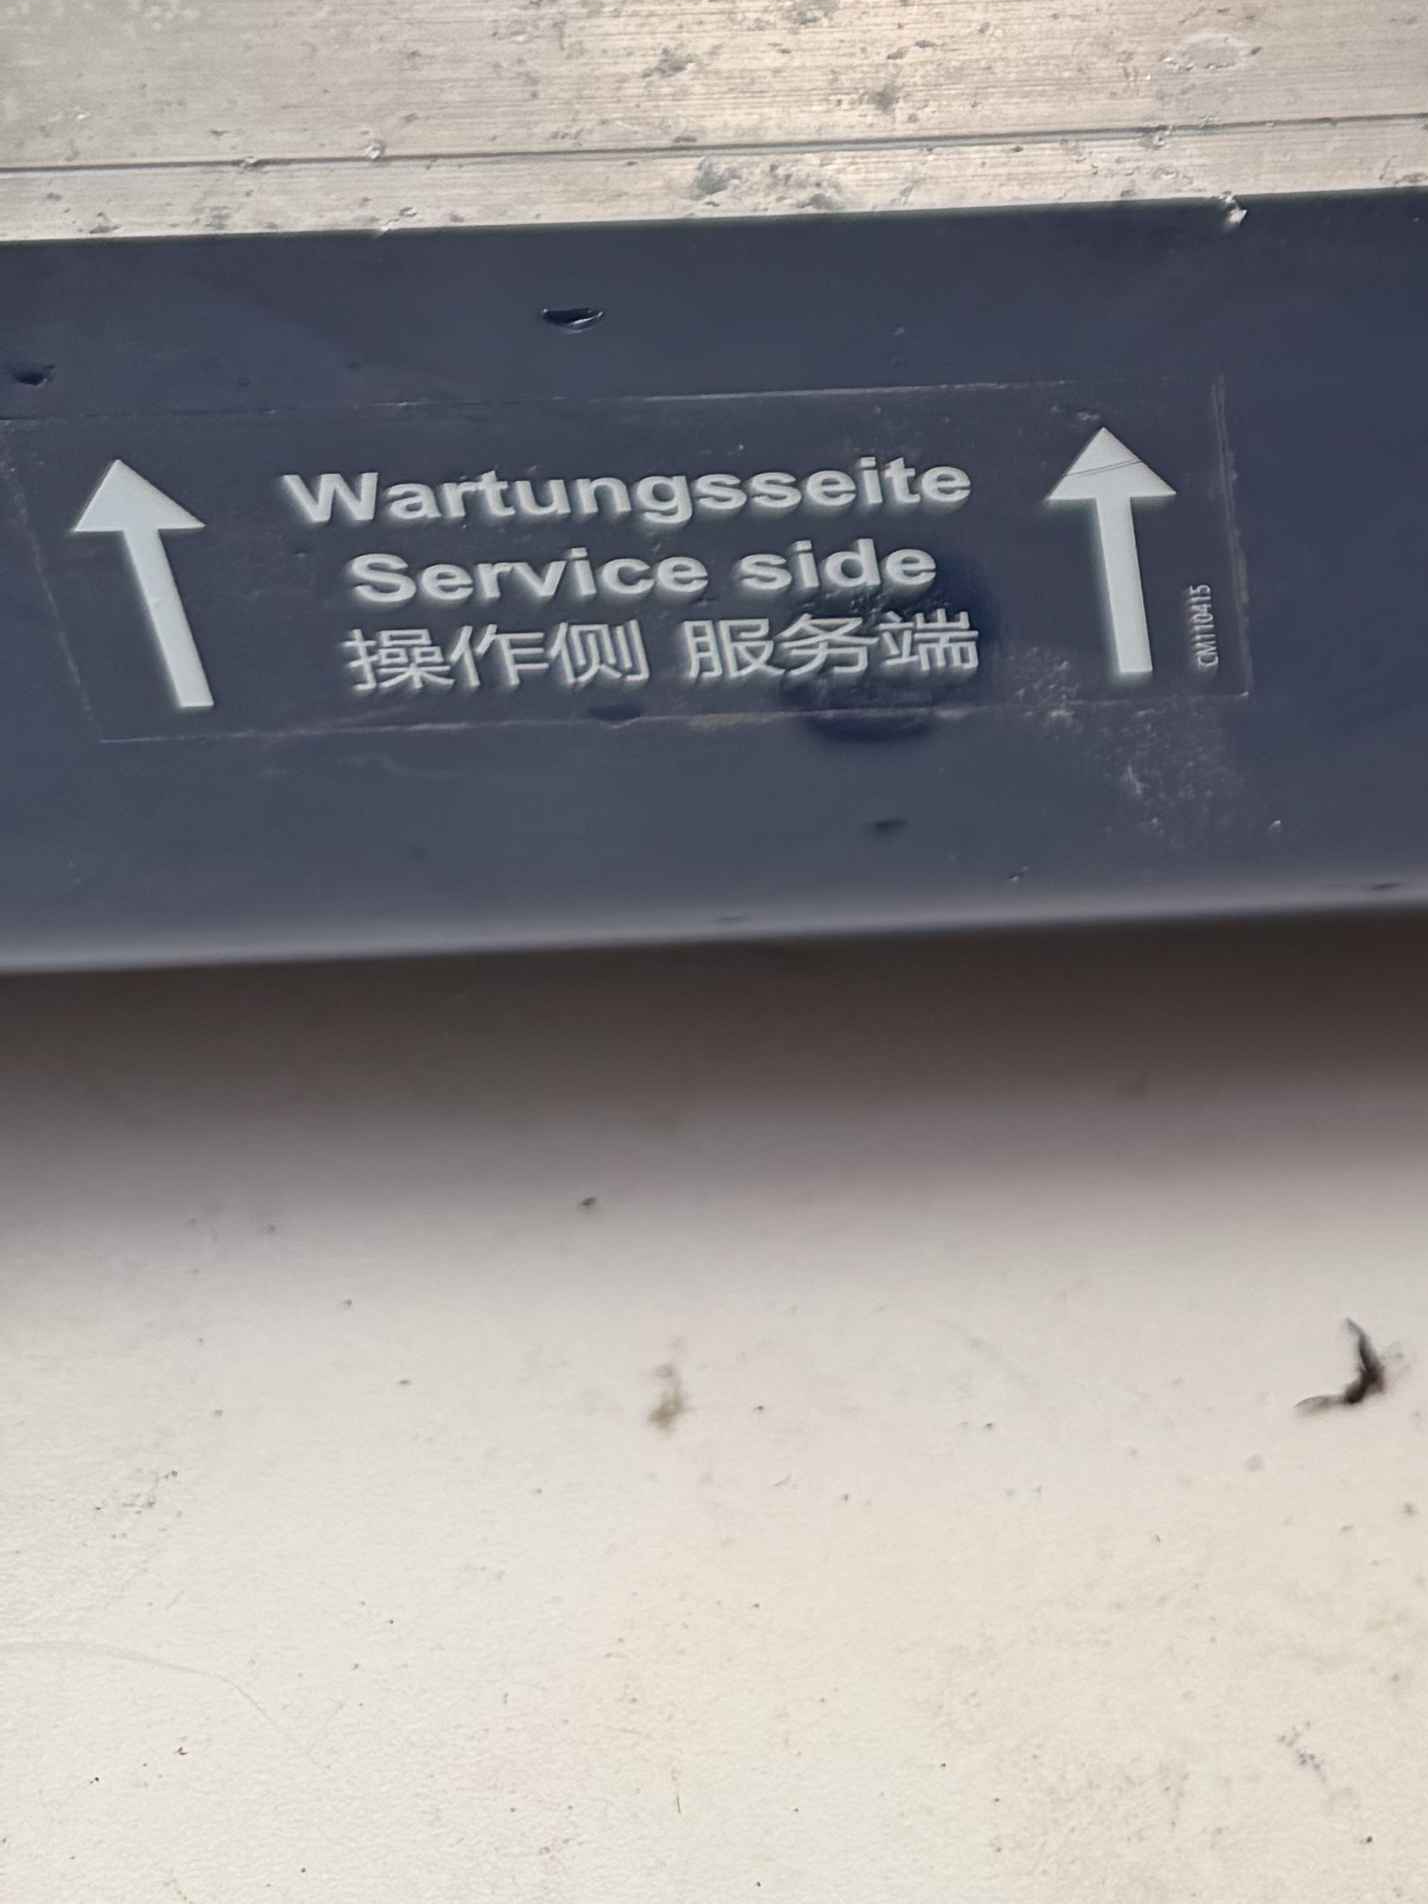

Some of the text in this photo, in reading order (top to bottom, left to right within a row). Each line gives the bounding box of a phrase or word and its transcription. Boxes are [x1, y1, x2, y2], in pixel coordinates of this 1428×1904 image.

[283, 457, 972, 525] Wartungsseite
[350, 539, 936, 603] Service side
[343, 608, 980, 692] 操作侧 服务端
